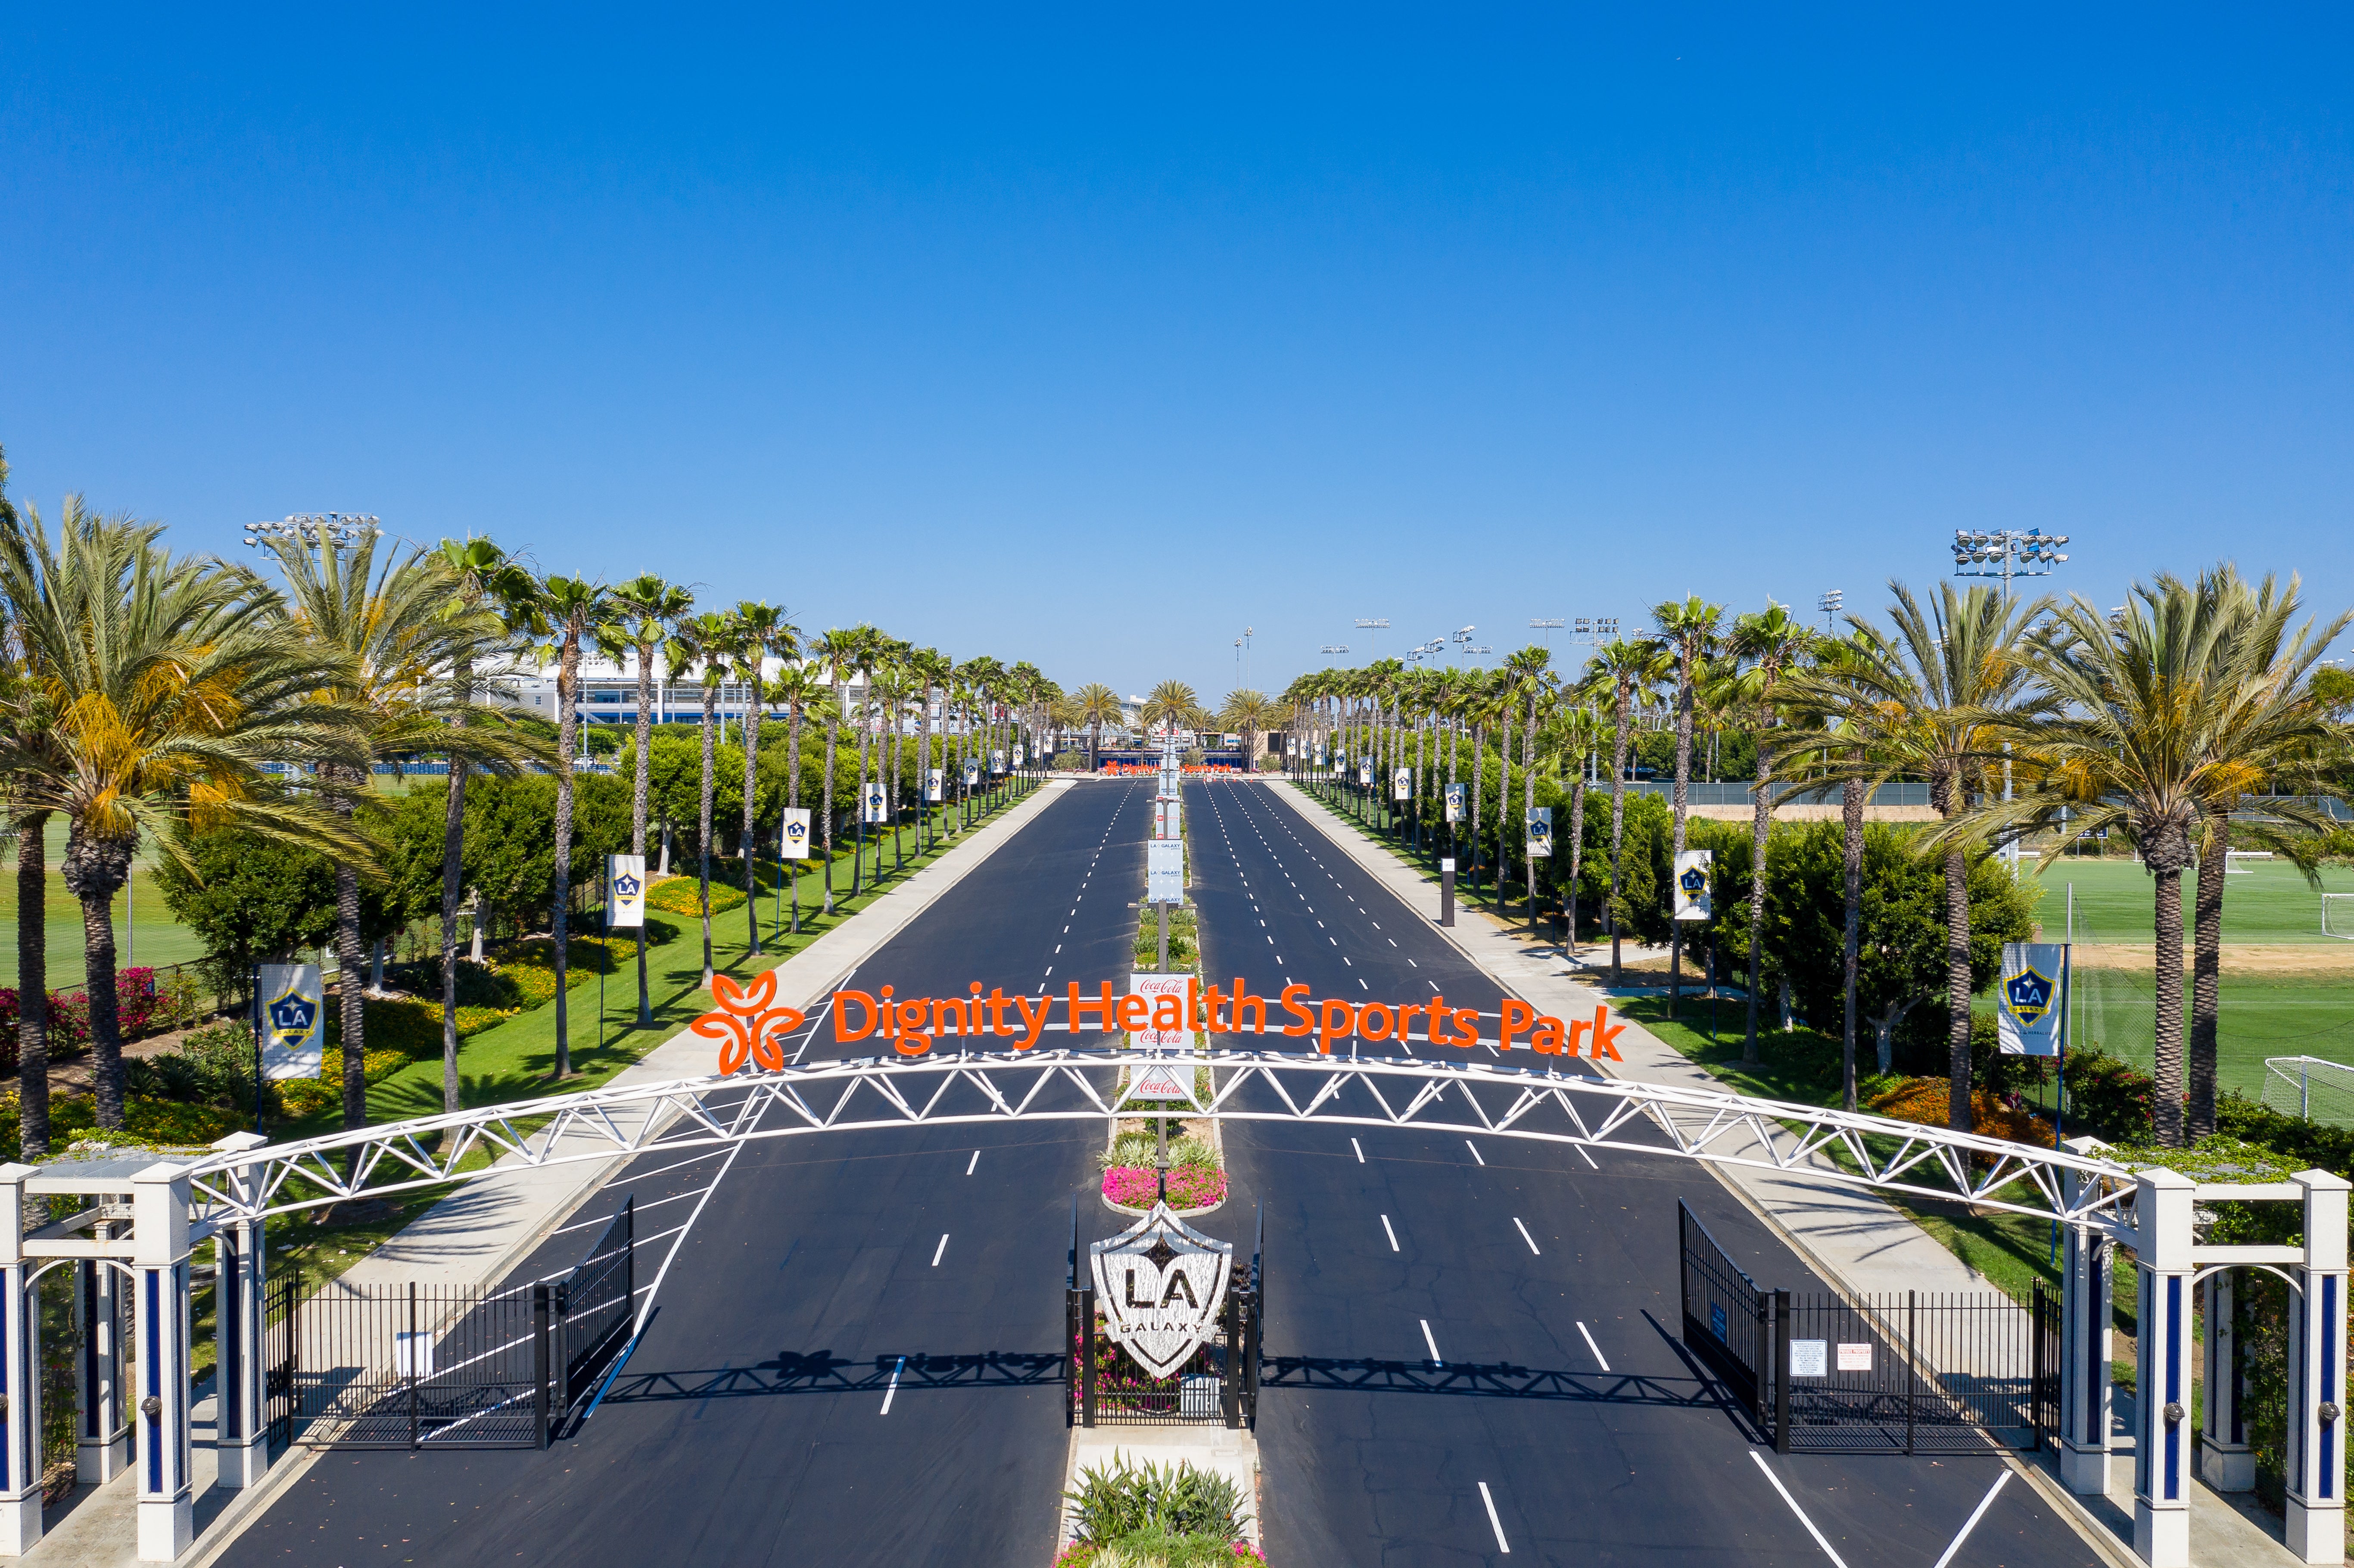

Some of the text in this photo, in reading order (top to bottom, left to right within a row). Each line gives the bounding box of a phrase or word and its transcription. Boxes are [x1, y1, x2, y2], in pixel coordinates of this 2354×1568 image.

[1123, 764, 1154, 775] Dignity
[1185, 764, 1211, 773] Sports
[1214, 764, 1231, 772] Park
[790, 828, 803, 836] LA
[618, 884, 636, 894] LA
[1685, 879, 1702, 888] LA
[1140, 979, 1184, 993] Coca-Cola
[2015, 987, 2043, 1004] LA
[278, 1010, 308, 1026] LA
[832, 978, 1626, 1062] Dignity Health Sports Park
[1126, 1269, 1199, 1309] LA
[1120, 1322, 1202, 1333] GALAXY
